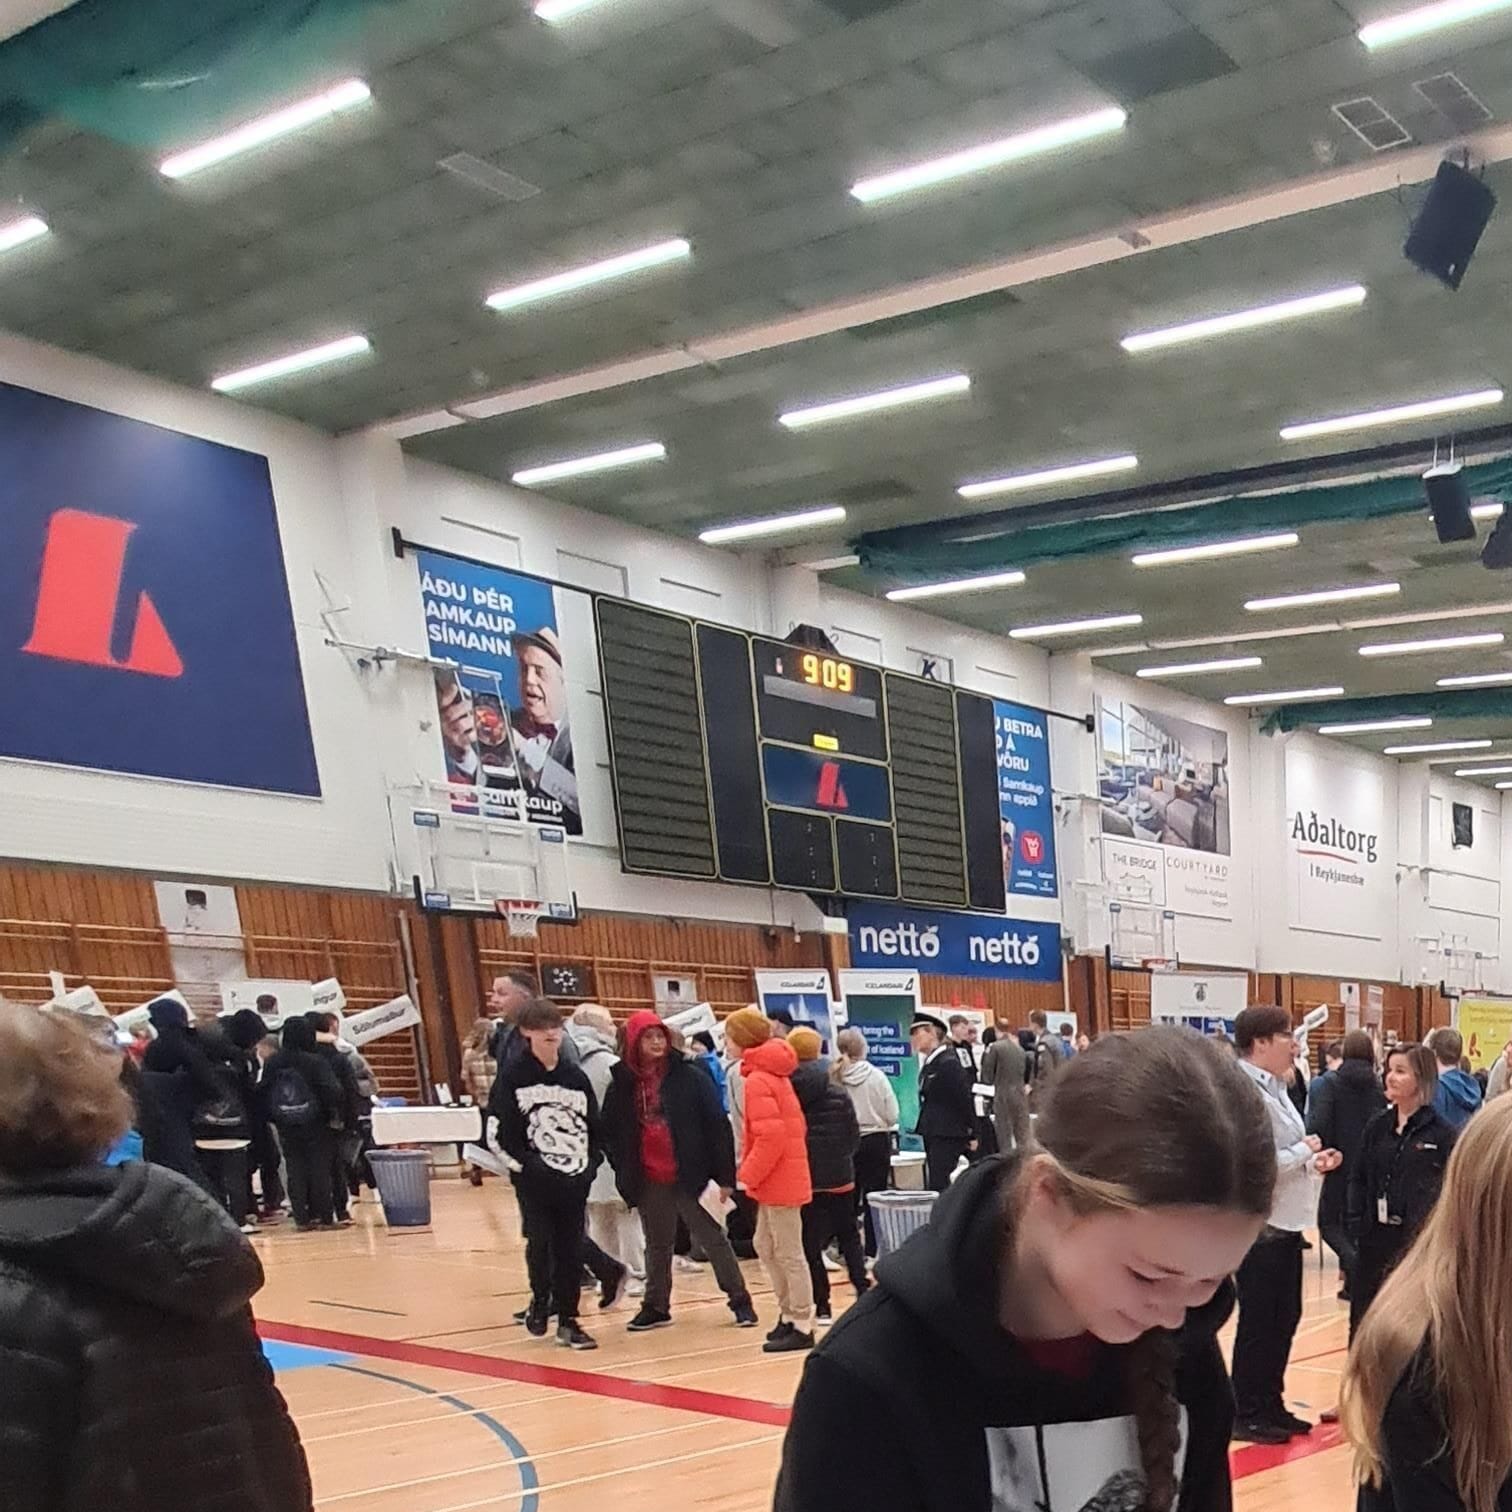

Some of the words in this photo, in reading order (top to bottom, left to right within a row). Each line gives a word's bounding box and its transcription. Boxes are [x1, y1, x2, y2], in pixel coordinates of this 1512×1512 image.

[422, 571, 467, 602] ÁÐU
[472, 587, 513, 613] ÞÉR
[427, 600, 516, 635] AMKAUP
[429, 621, 512, 657] SÍMANN
[1003, 718, 1043, 739] BETRA
[1292, 811, 1377, 863] Aðaltorg
[1113, 853, 1127, 866] THE
[1166, 857, 1228, 877] COURTYARD
